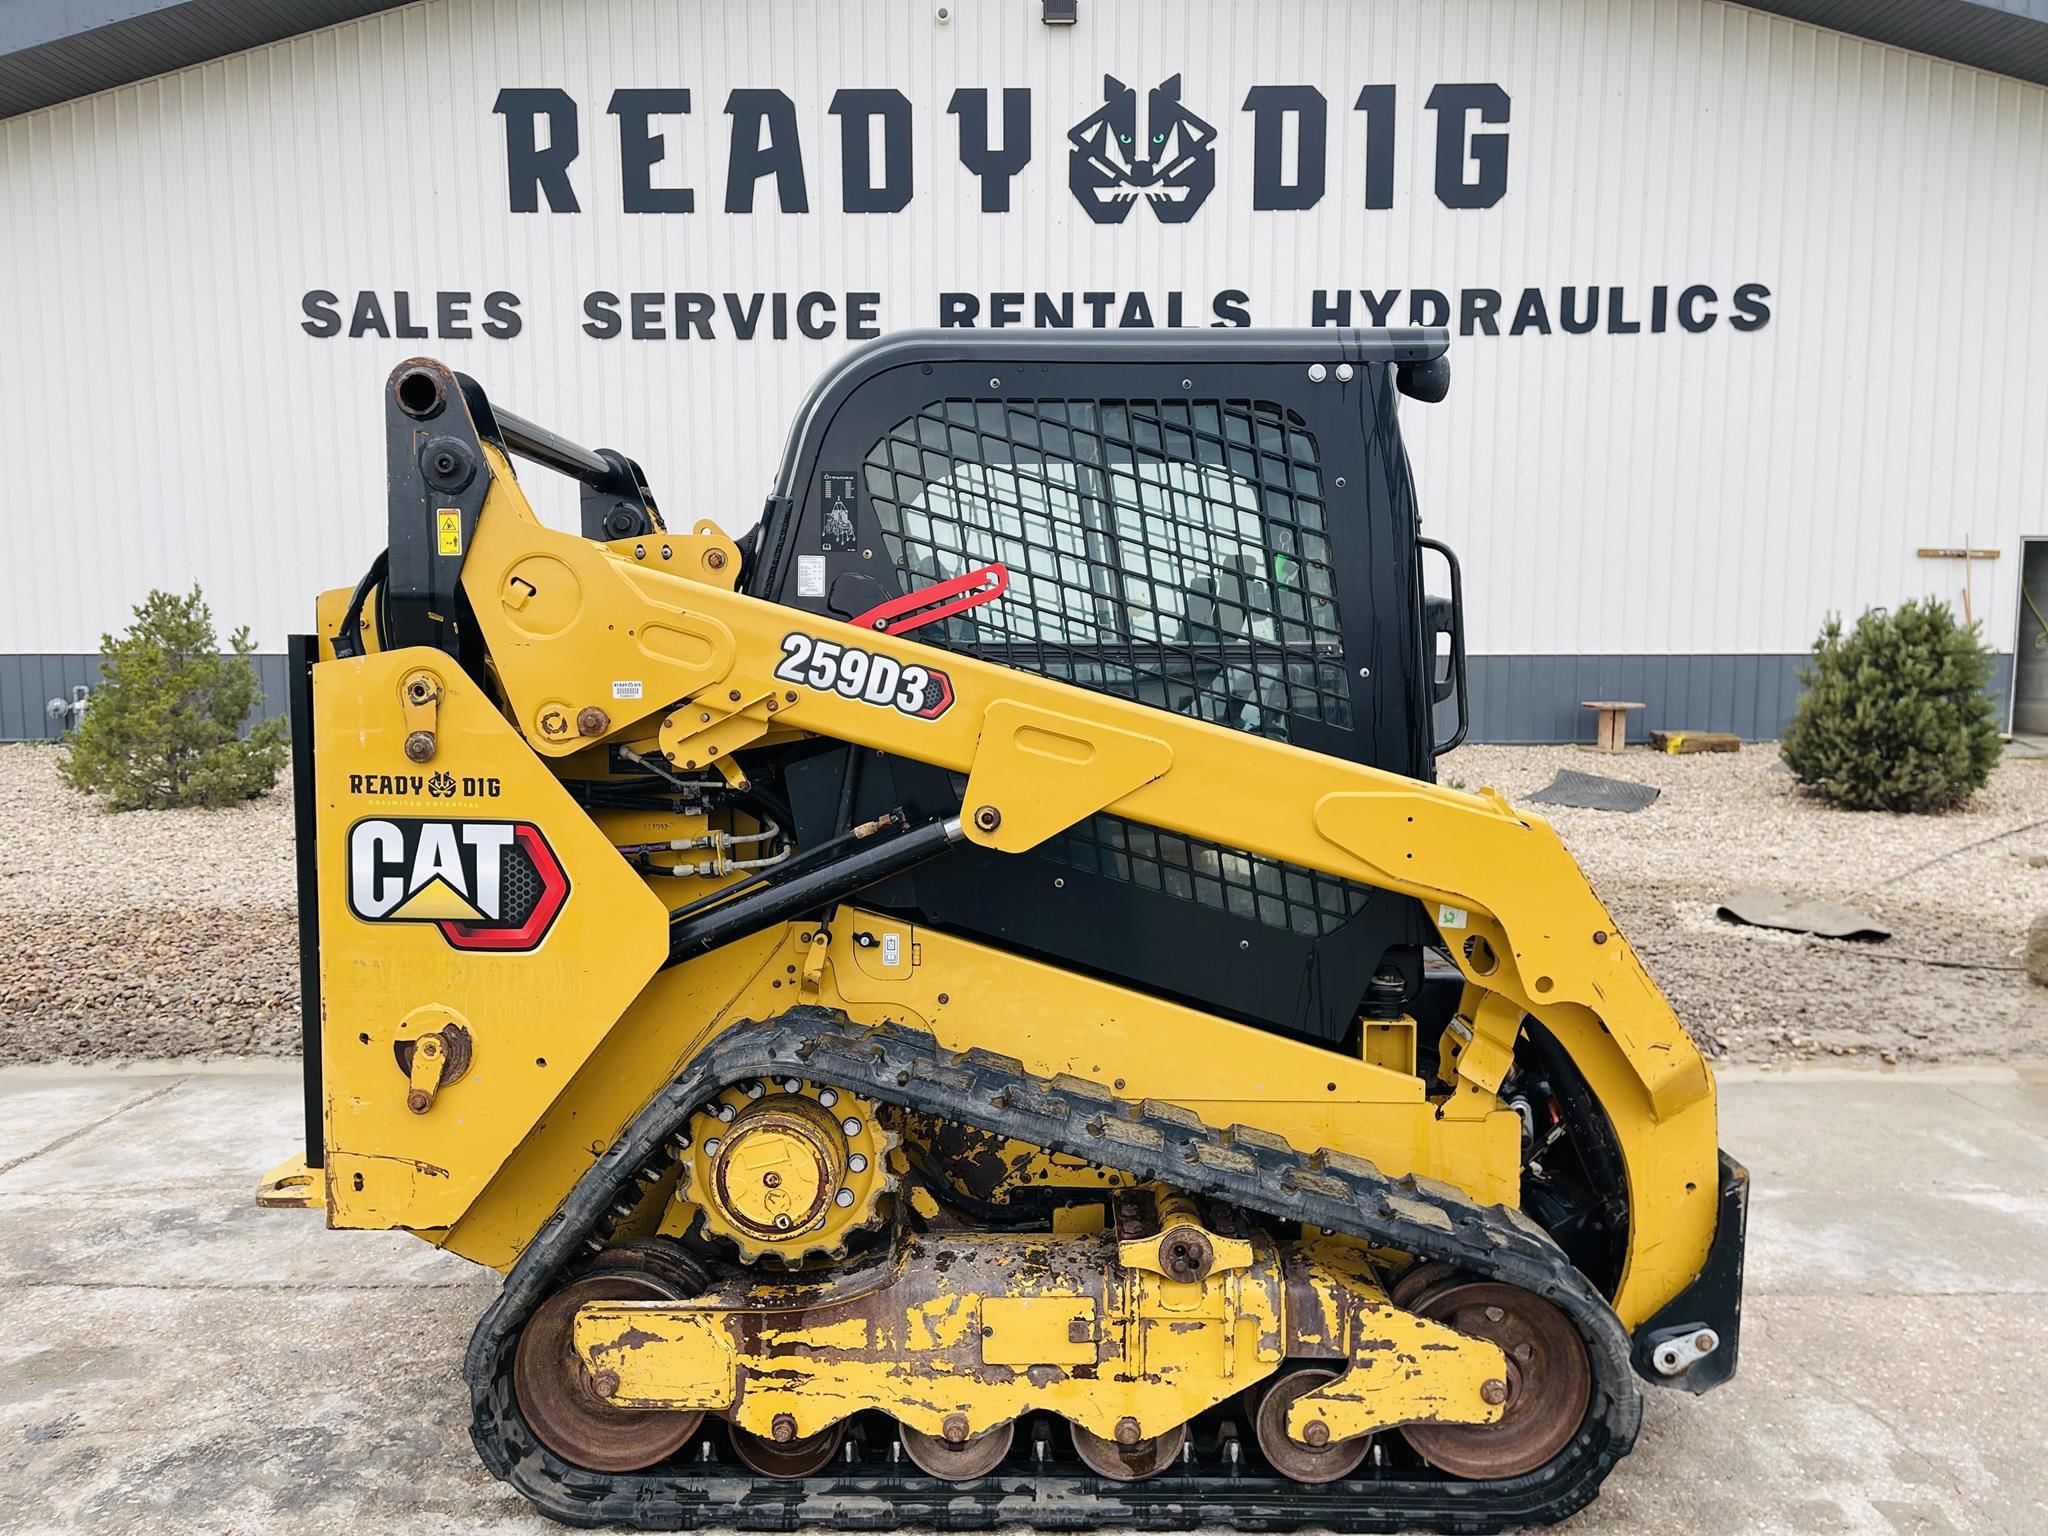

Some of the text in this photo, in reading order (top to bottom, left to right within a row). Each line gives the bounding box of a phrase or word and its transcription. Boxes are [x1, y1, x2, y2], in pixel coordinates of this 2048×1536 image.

[493, 84, 1512, 214] READY DIG
[302, 283, 1772, 341] SALES SERVICE RENTALS HYDRAULICS
[774, 632, 932, 714] 259D3
[349, 774, 501, 798] READY DIG
[351, 820, 515, 919] CAT
